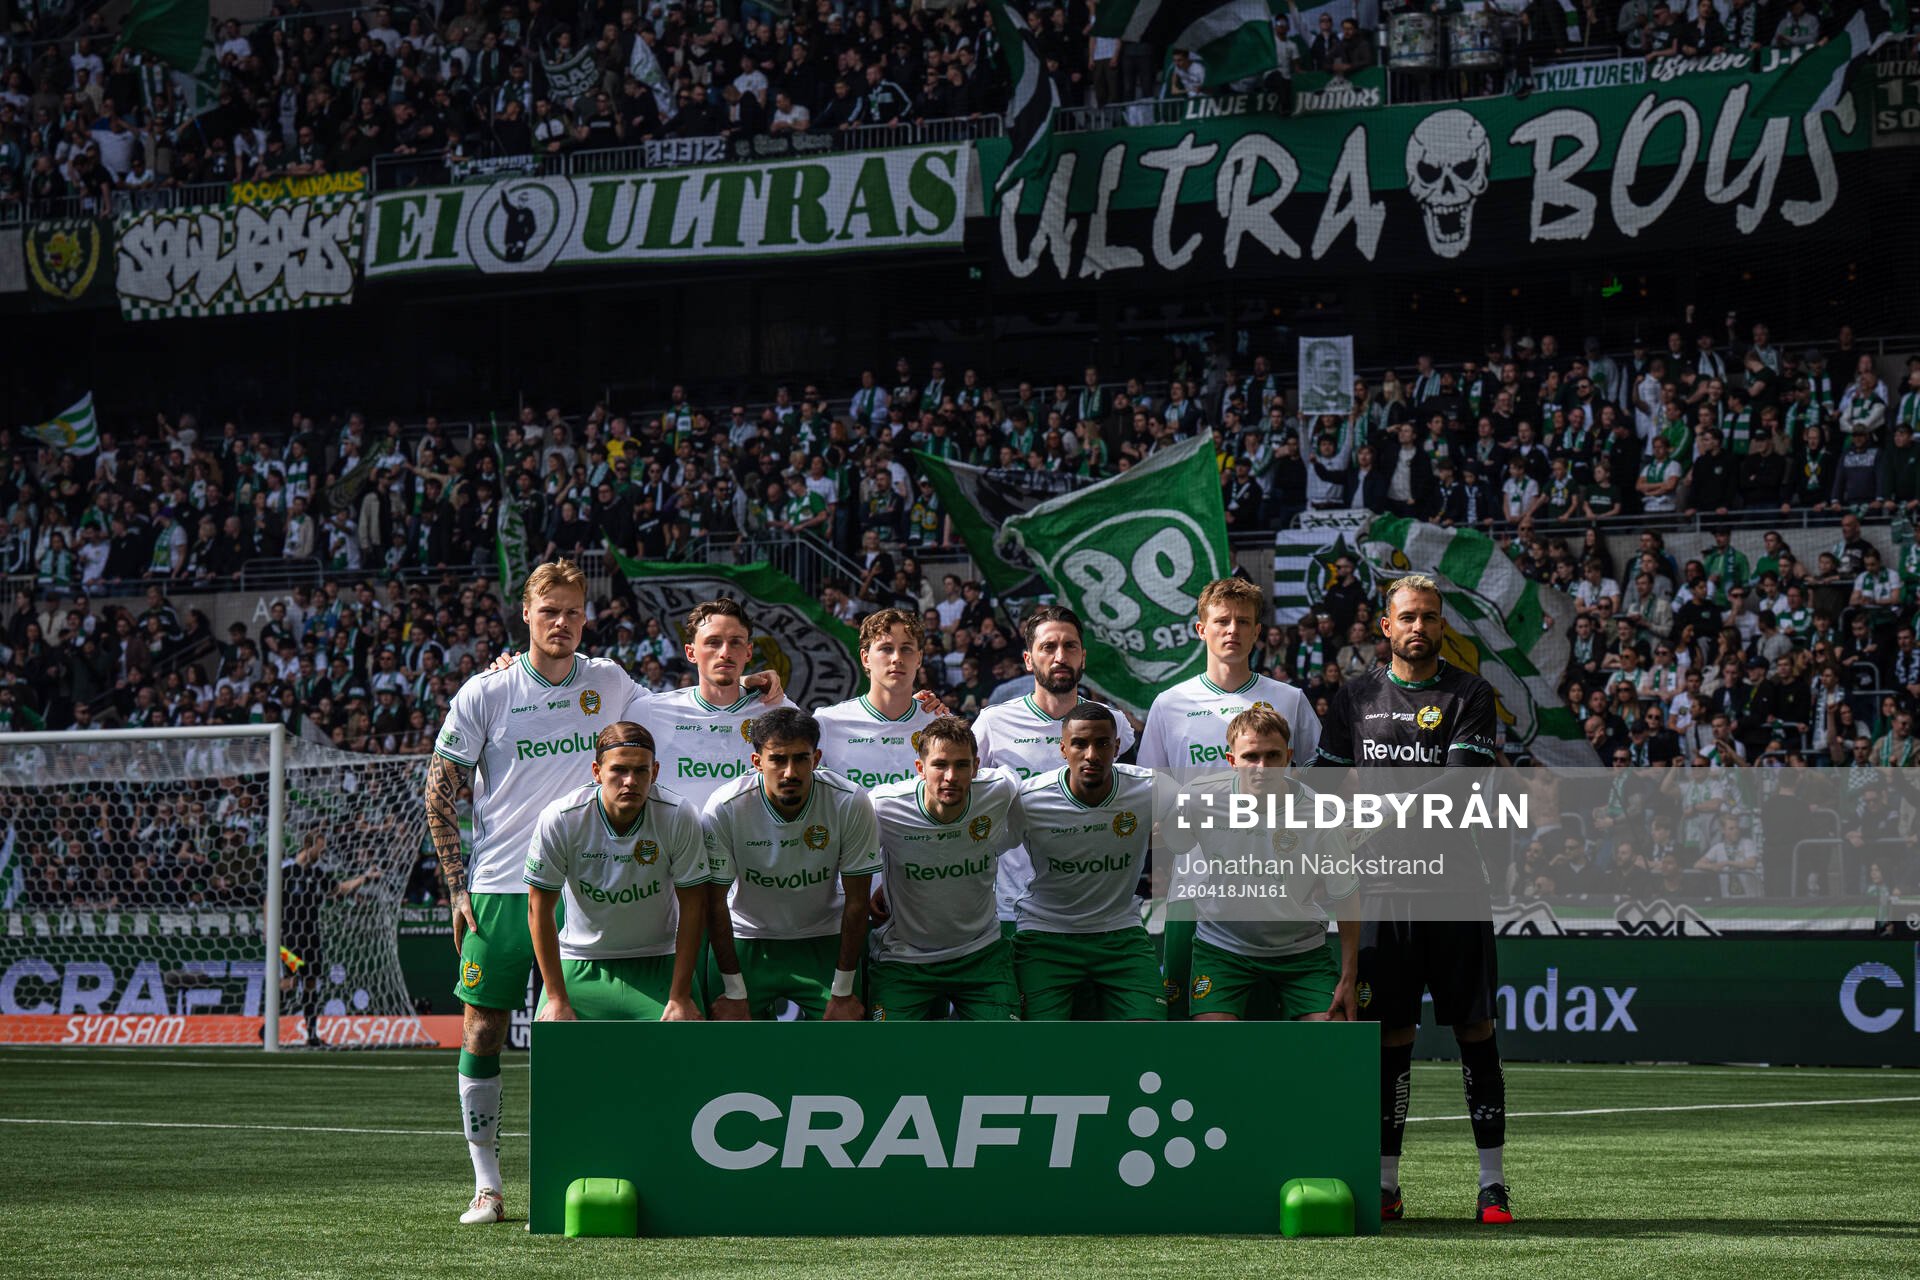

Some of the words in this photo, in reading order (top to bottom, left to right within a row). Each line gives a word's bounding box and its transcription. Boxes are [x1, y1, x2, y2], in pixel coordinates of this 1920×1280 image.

[1503, 61, 1645, 94] MTKULTUREN
[1877, 61, 1920, 79] ULTR
[1185, 95, 1249, 120] LINJE
[232, 181, 285, 204] 100%
[285, 169, 365, 198] VANDALS
[1000, 125, 1386, 279] ULTRA
[1509, 83, 1857, 243] BOYS
[583, 150, 958, 253] ULTRAS
[512, 705, 532, 713] CRAFT
[517, 732, 599, 760] Revolut
[1362, 739, 1442, 764] Revolut
[678, 757, 748, 778] Revol
[904, 854, 990, 881] Revolut
[1047, 852, 1132, 874] Revolut
[745, 865, 830, 889] Revolut
[579, 880, 661, 904] Revolut
[1496, 967, 1639, 1032] ndax
[691, 1092, 1111, 1170] CRAFT
